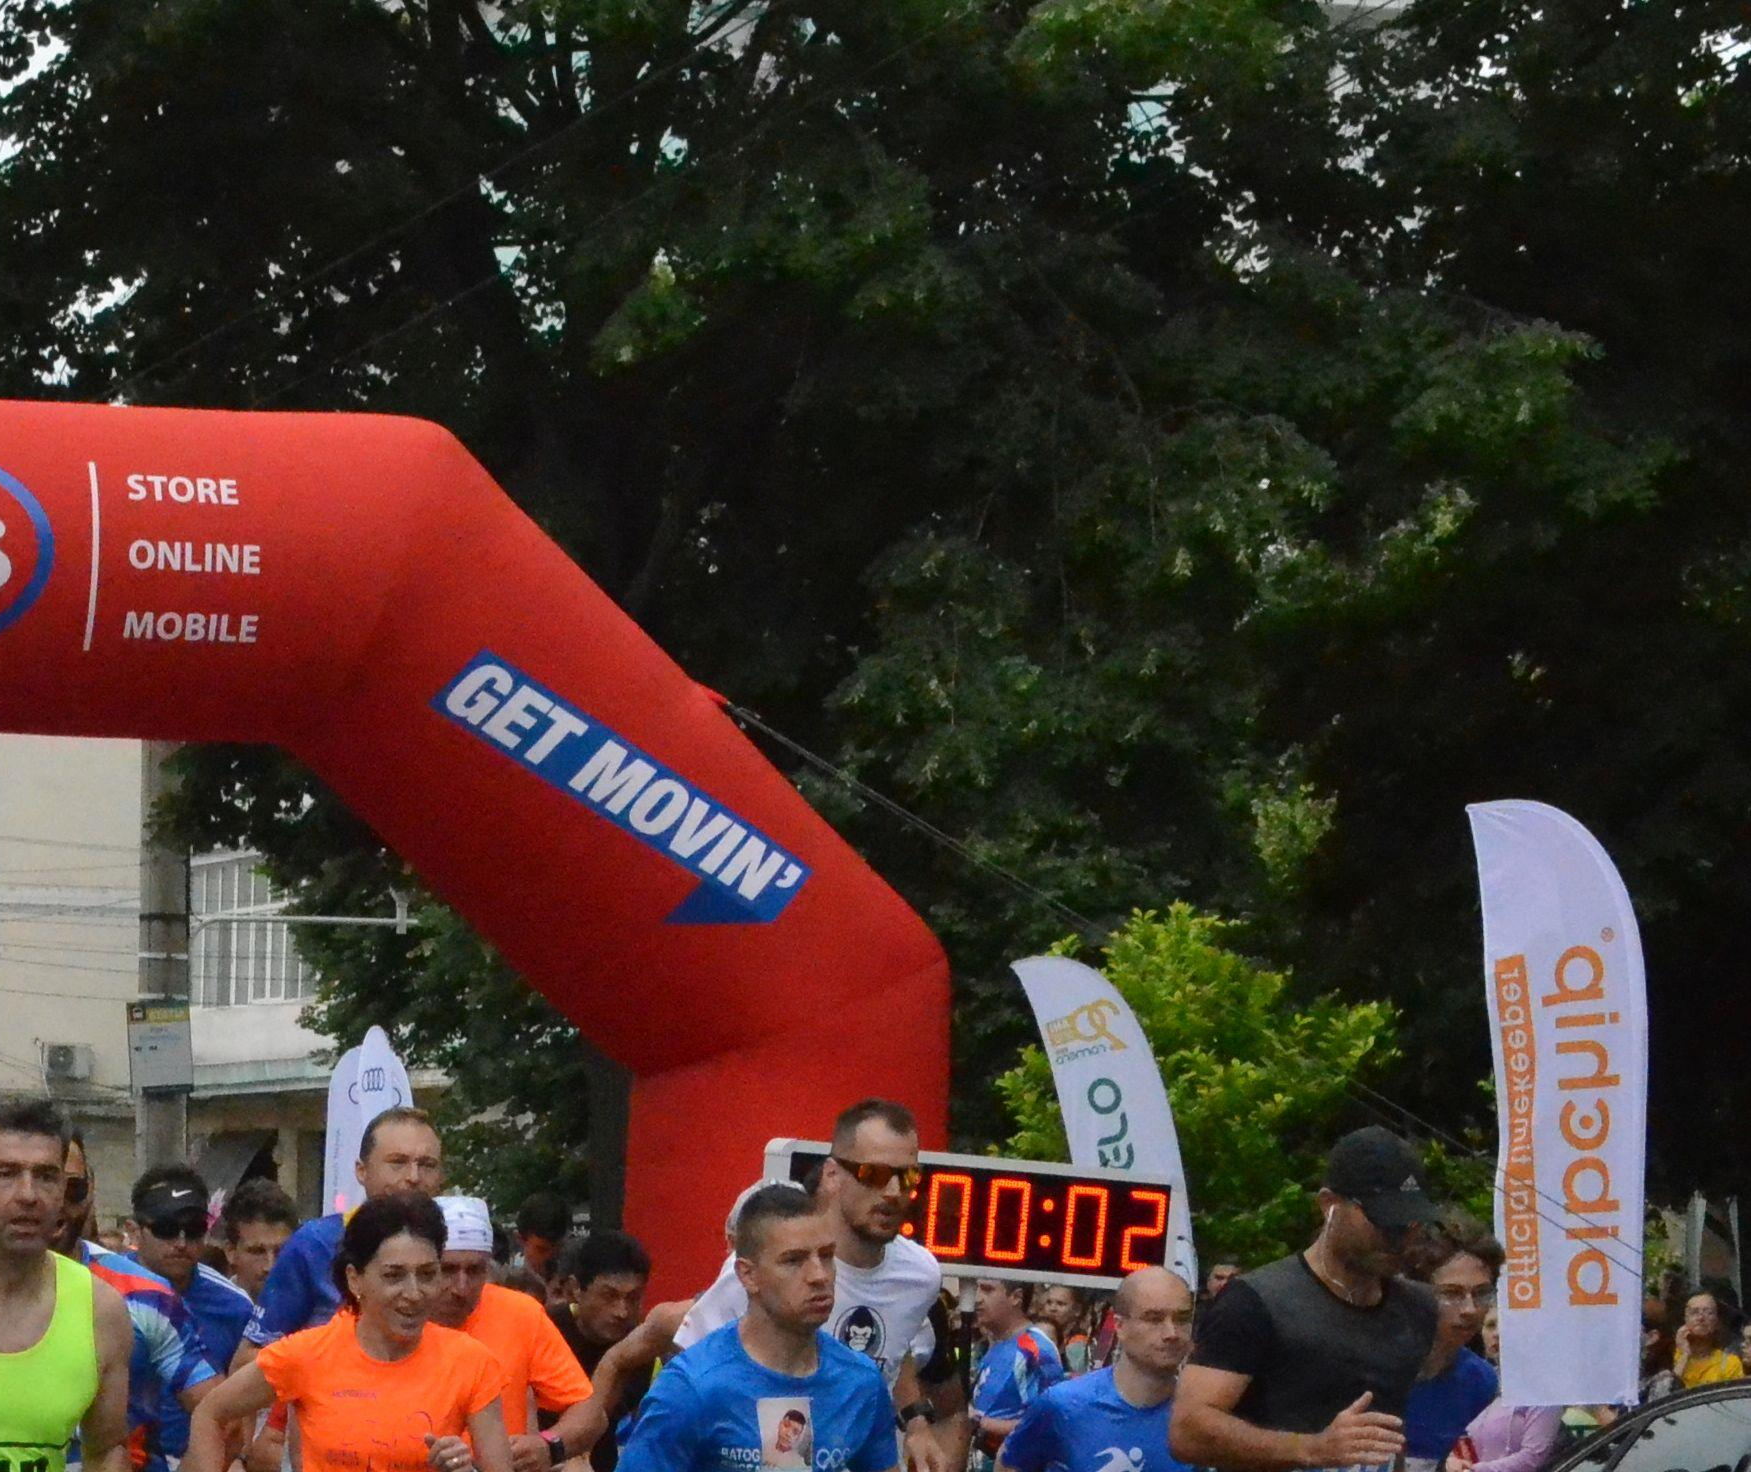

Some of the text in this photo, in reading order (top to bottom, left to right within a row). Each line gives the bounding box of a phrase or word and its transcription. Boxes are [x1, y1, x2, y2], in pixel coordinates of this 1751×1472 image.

[127, 475, 239, 505] STORE
[129, 541, 261, 575] ONLINE
[123, 611, 260, 644] MOBILE
[446, 664, 803, 901] GET MOVIN'
